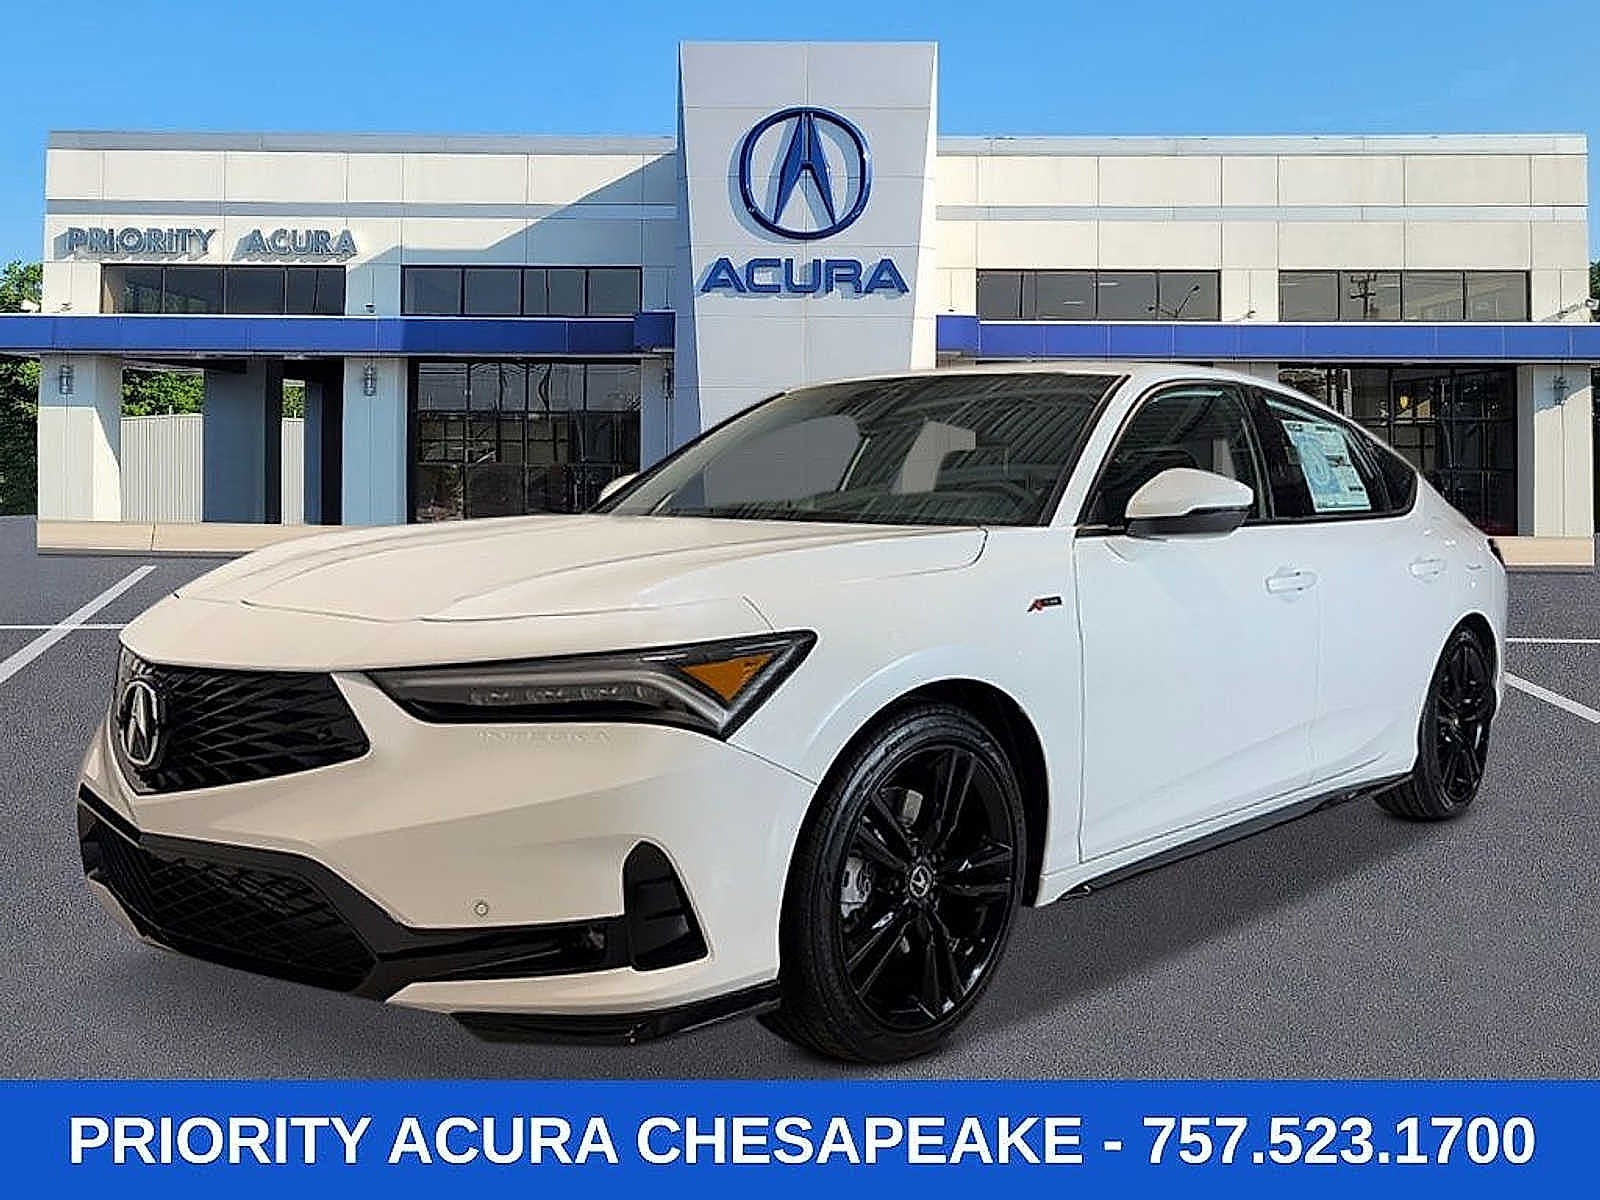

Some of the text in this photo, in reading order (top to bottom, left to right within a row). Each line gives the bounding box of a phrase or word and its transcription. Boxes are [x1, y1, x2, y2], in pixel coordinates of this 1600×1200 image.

[67, 226, 358, 255] PRIORITY ACURA
[701, 257, 910, 294] ACURA
